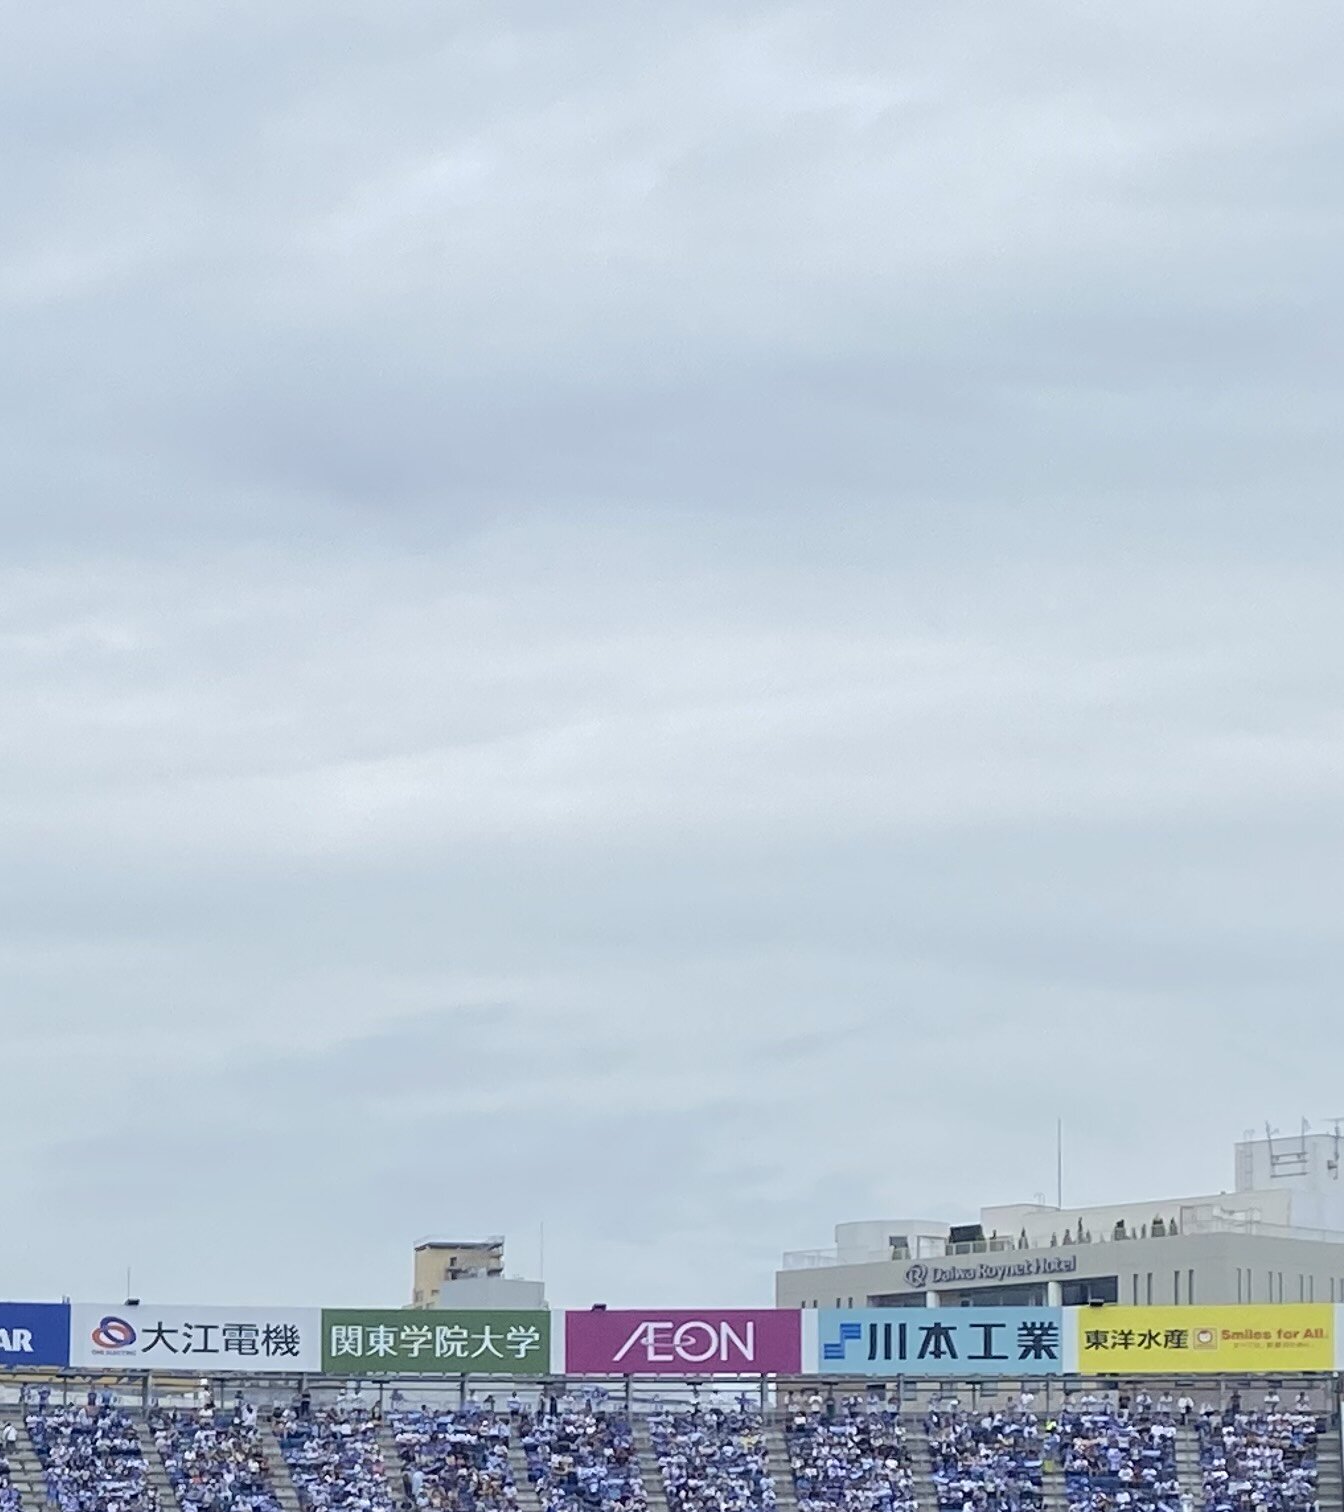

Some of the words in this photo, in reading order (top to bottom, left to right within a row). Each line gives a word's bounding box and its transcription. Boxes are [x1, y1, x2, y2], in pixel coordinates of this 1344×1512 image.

[932, 1266, 975, 1283] Daiwa
[979, 1259, 1031, 1282] Roynet
[1033, 1255, 1077, 1274] Hotel
[141, 1321, 301, 1358] 大江電機
[330, 1324, 542, 1360] 関東学院大学
[868, 1321, 1060, 1361] 川本工業
[1084, 1329, 1189, 1350] 東洋水産
[1221, 1328, 1271, 1341] Smiles
[1277, 1328, 1300, 1340] for
